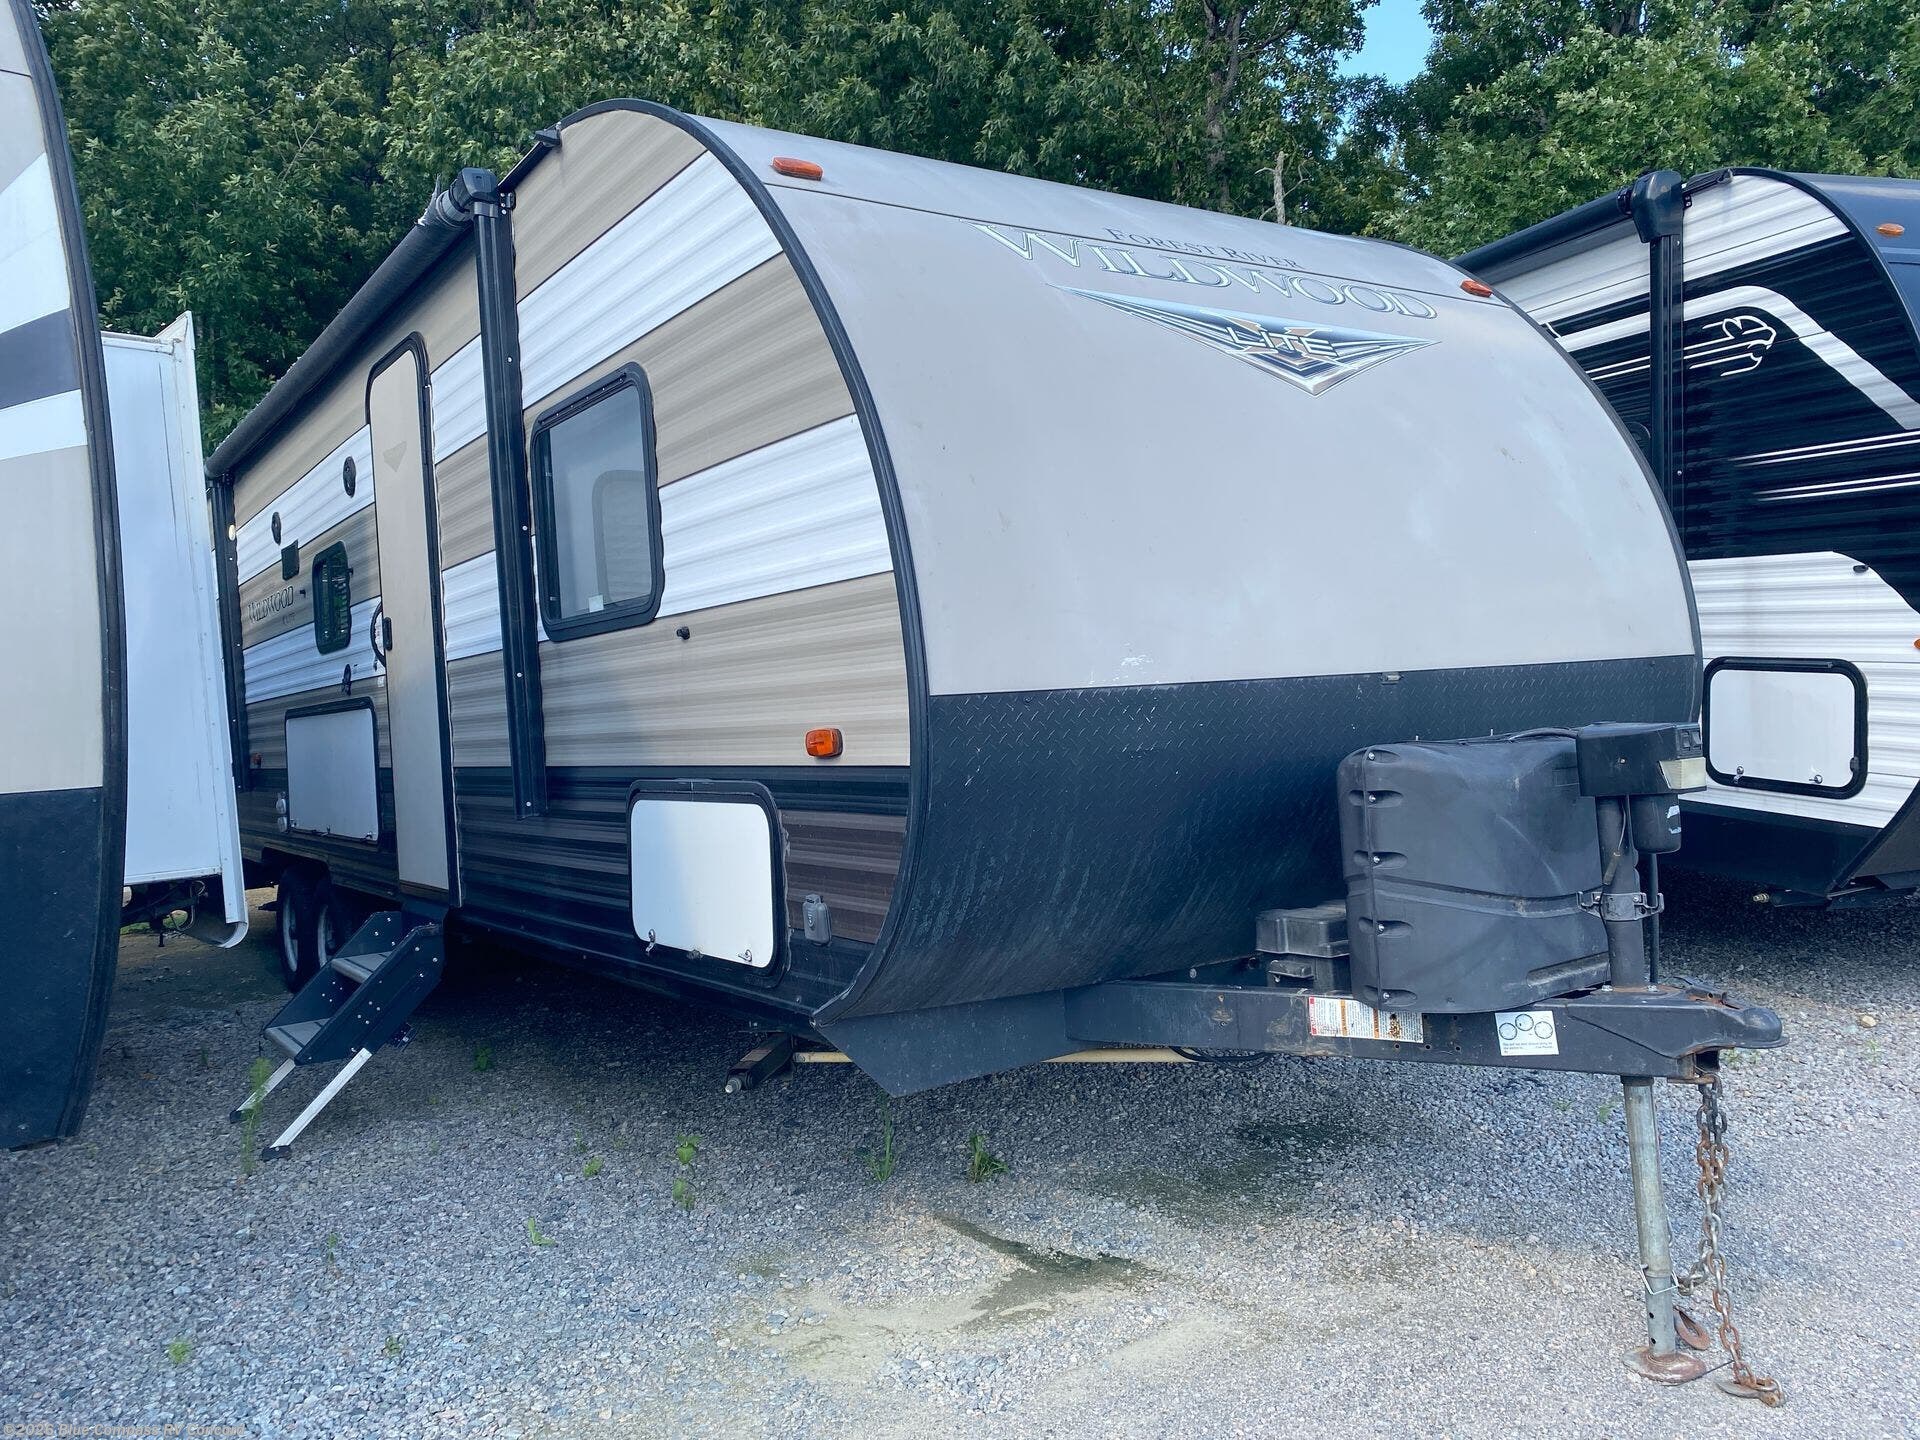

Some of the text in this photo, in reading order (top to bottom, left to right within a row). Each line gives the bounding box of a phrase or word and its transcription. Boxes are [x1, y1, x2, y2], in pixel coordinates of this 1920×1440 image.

[1104, 227, 1304, 269] FOREST RIVER
[960, 218, 1438, 319] WILDWOOD
[1226, 326, 1338, 358] LITE
[248, 585, 294, 621] WILDWOOD
